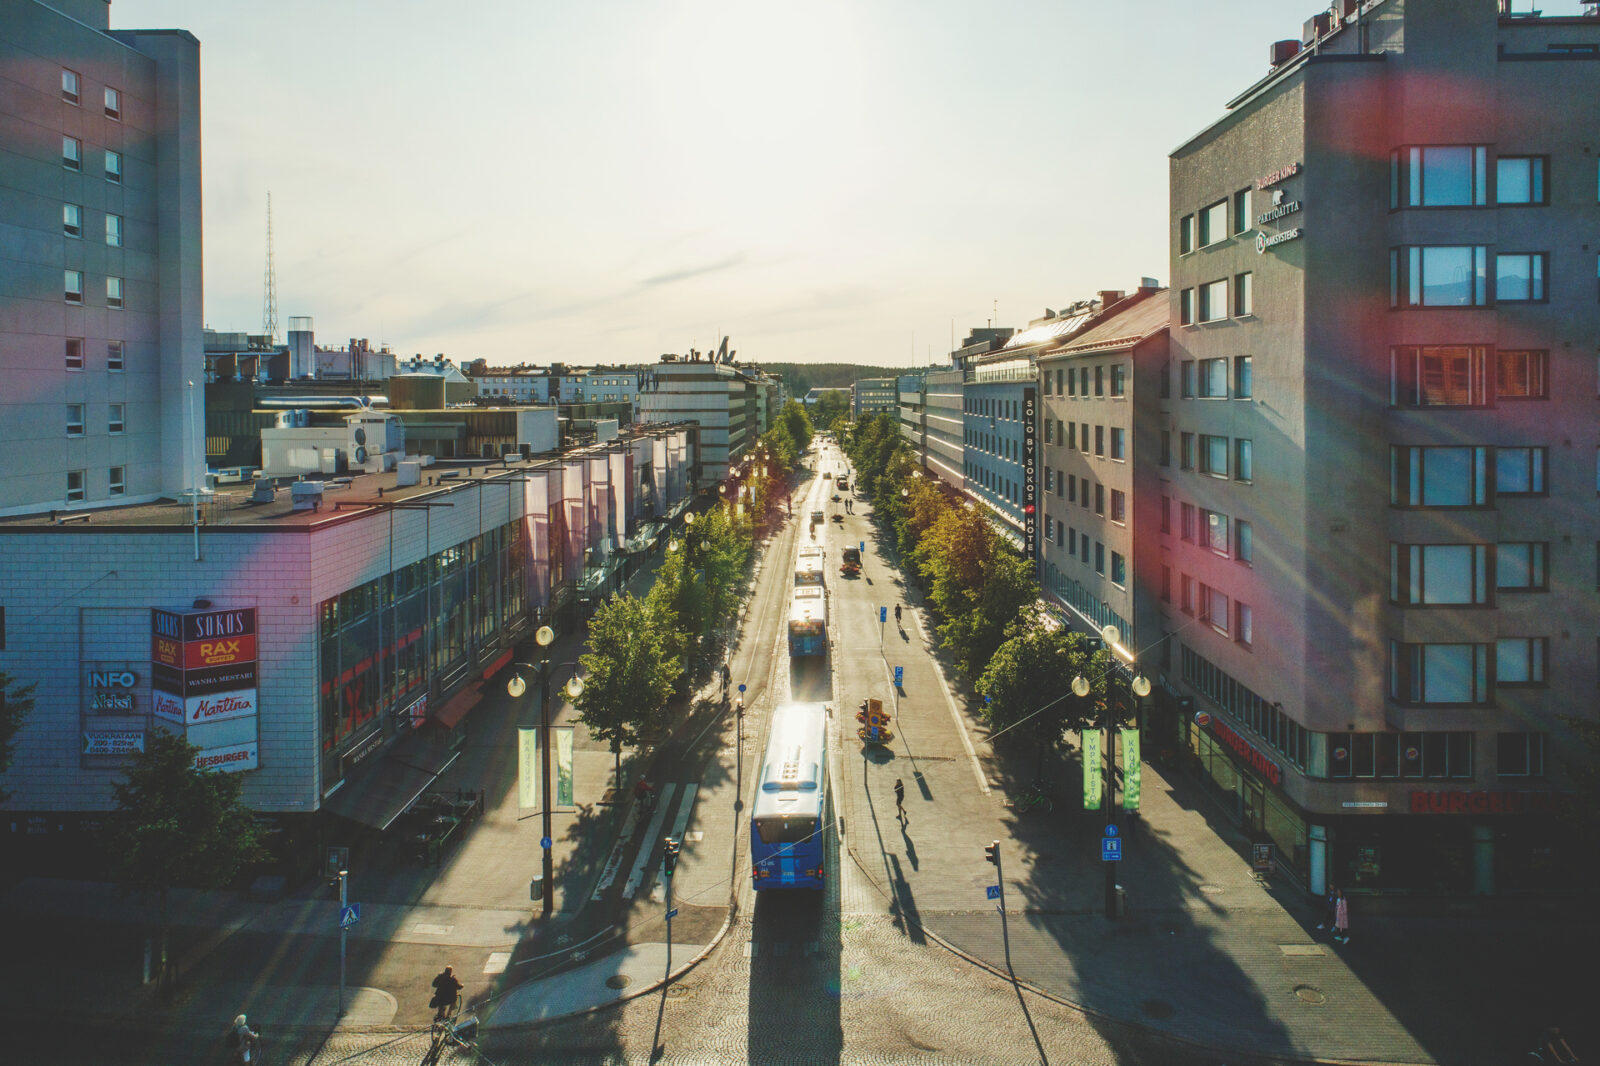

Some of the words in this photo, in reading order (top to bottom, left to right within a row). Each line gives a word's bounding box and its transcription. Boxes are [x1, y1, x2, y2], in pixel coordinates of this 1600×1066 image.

[1256, 170, 1280, 190] BURGER
[1280, 162, 1297, 180] KING
[1026, 400, 1034, 433] SOLO
[1026, 438, 1034, 454] BY
[1026, 459, 1034, 500] SOKOS
[1026, 518, 1034, 560] HOTEL
[156, 611, 179, 637] SOKOS
[195, 612, 244, 638] SOKOS
[158, 639, 177, 657] RAX
[200, 640, 241, 657] RAX
[88, 672, 135, 688] INFO
[188, 677, 217, 687] WANHA
[219, 672, 253, 682] MESTARI
[90, 694, 132, 710] Aleksi
[193, 696, 252, 719] Martina
[196, 751, 250, 768] HESBURGER
[1214, 716, 1250, 762] BURGER
[1252, 748, 1279, 785] KING
